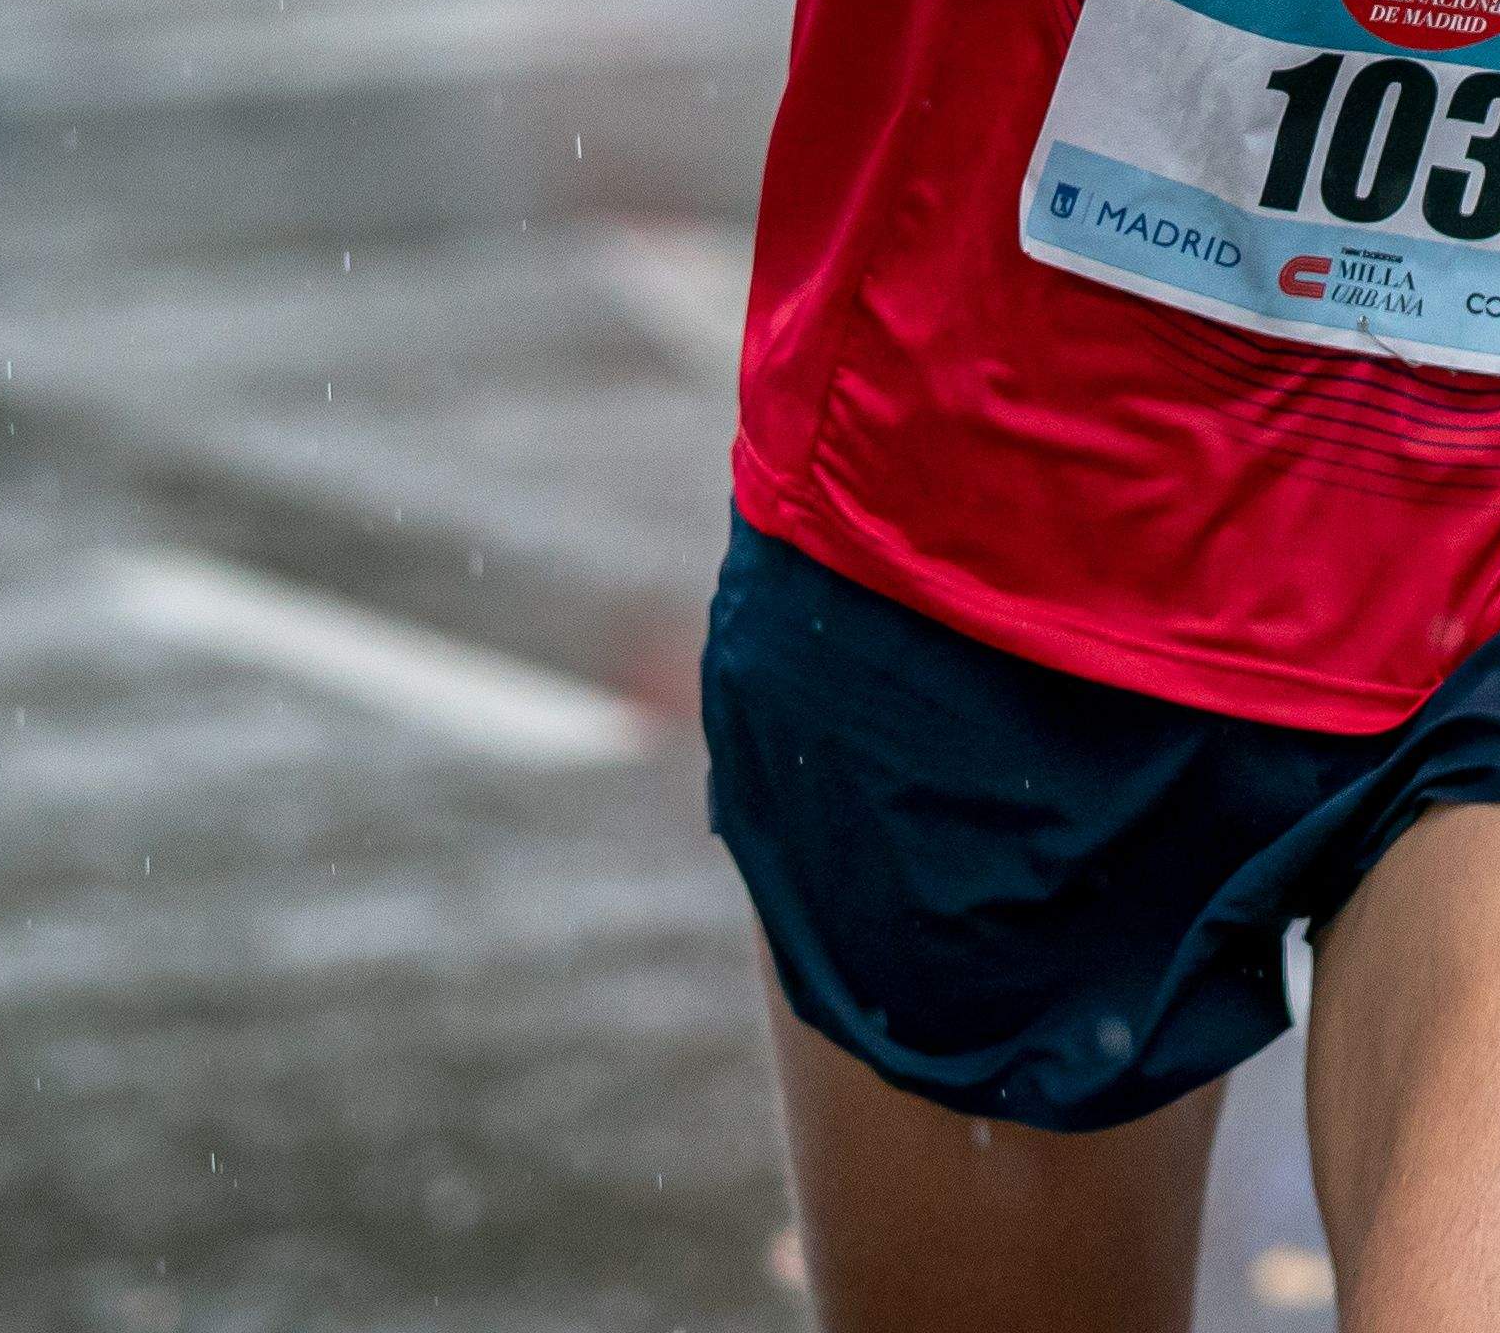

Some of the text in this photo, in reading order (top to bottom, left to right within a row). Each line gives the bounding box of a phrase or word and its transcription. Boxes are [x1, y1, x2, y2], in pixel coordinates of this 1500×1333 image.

[1369, 4, 1489, 34] DE MADRID
[1096, 200, 1242, 269] MADRID
[1338, 258, 1416, 292] MILLA
[1331, 284, 1423, 317] URBANA
